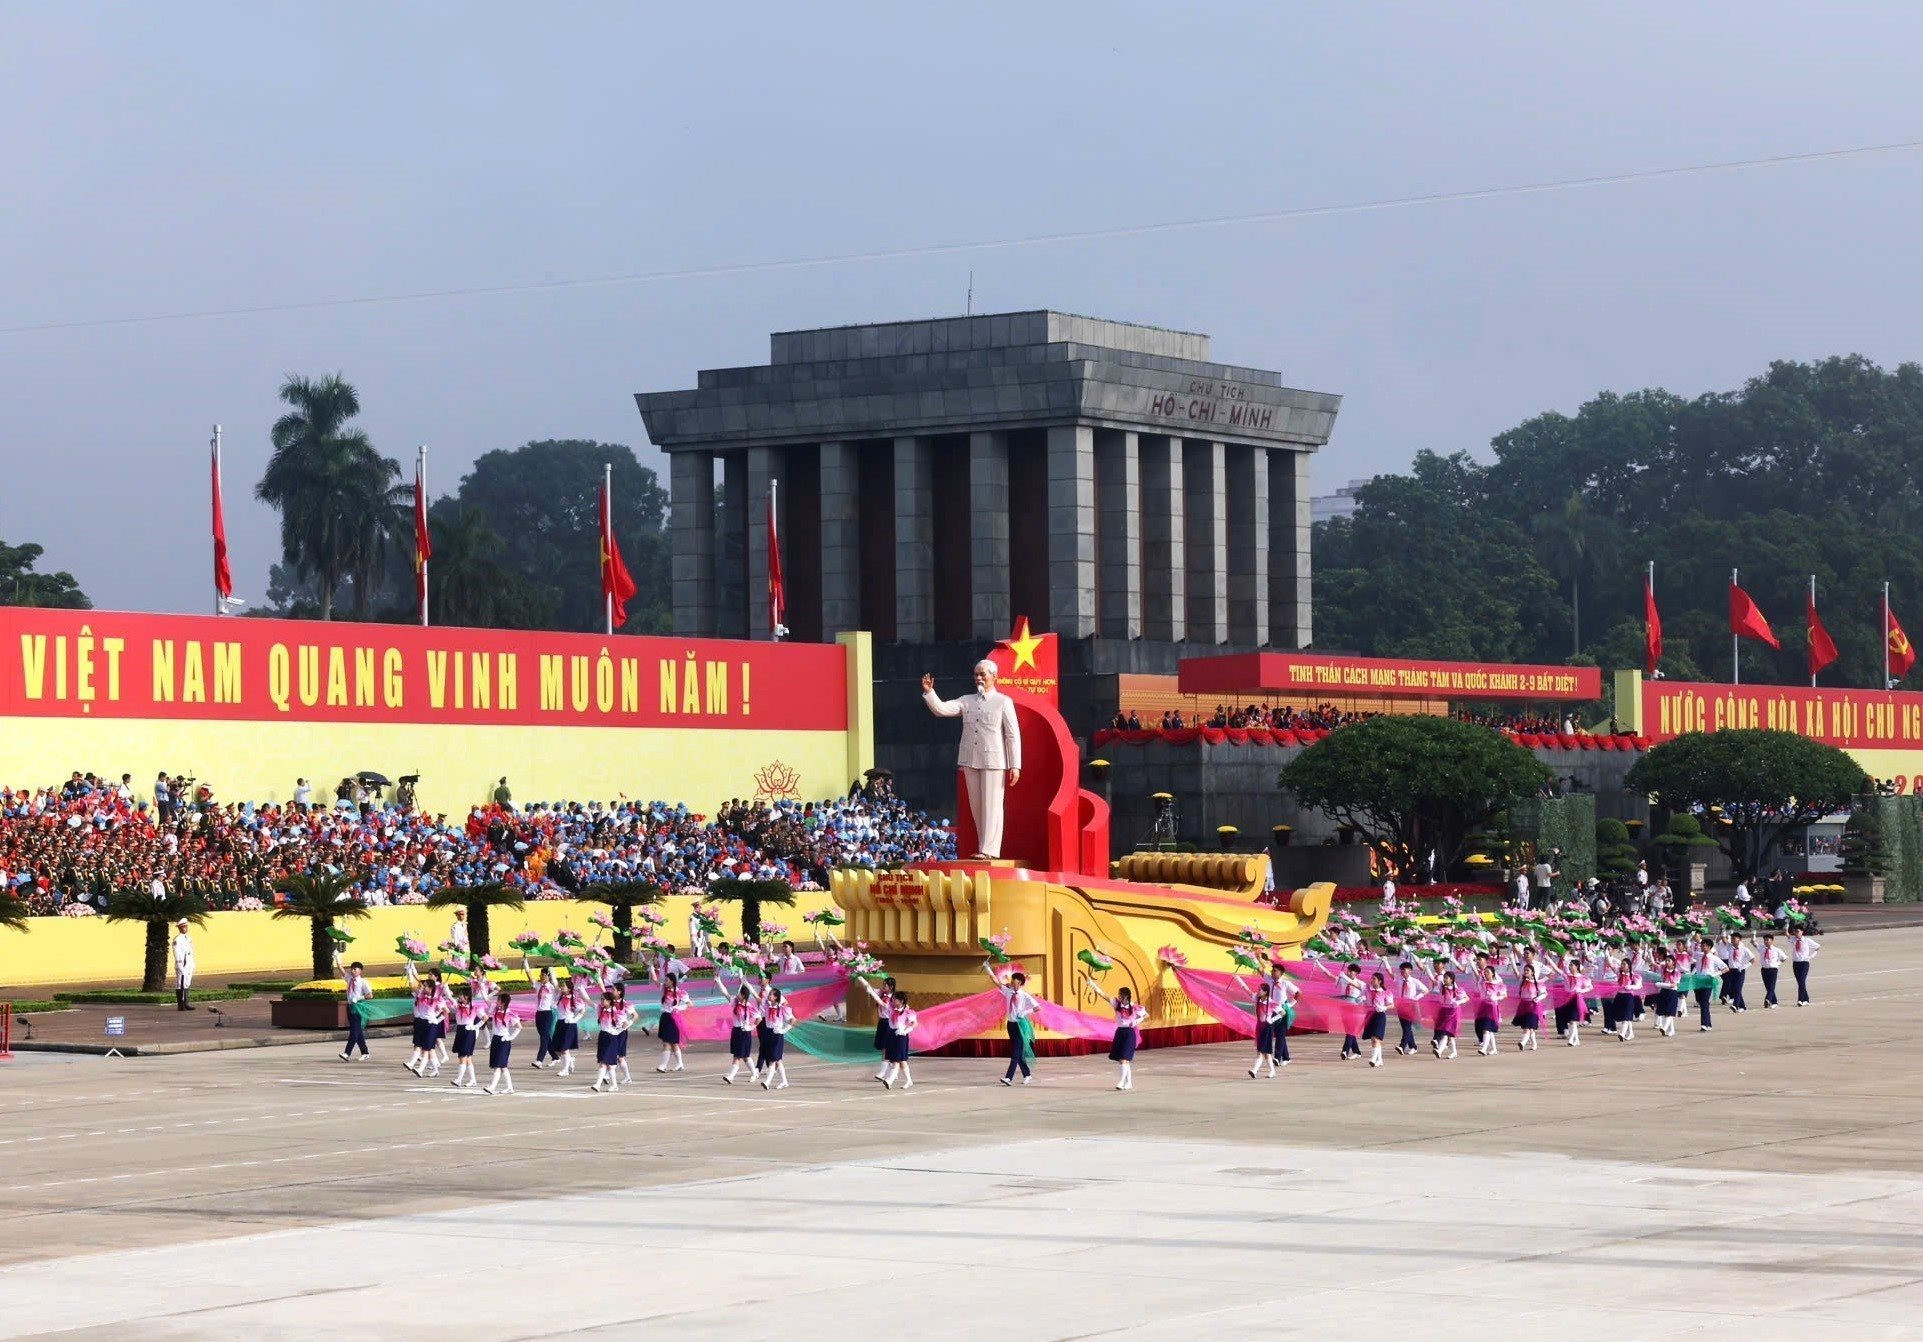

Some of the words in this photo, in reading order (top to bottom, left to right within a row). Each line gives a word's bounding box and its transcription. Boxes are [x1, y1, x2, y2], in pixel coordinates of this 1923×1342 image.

[21, 625, 125, 713] VIỆT
[153, 639, 243, 704] NAM
[268, 643, 404, 711] QUANG
[427, 650, 518, 710] VINH
[540, 647, 639, 713] MUÔN
[660, 650, 728, 715] NĂM
[1289, 664, 1313, 682] TINH
[1344, 664, 1368, 685] CÁCH
[1370, 668, 1396, 687] MẠNG
[1398, 667, 1428, 687] THÁNG
[1430, 668, 1449, 688] TÁM
[1451, 669, 1463, 688] VÀ
[1465, 668, 1487, 689] QUỐC
[1489, 671, 1517, 690] KHÁNH
[1519, 674, 1535, 690] 2-9
[1537, 671, 1553, 691] BẤT
[1661, 690, 1705, 735] NƯỚC
[1768, 693, 1798, 735] HÒA
[1806, 695, 1824, 737] XÃ
[1832, 695, 1858, 745] HỘI
[1866, 695, 1895, 739] CHỦ
